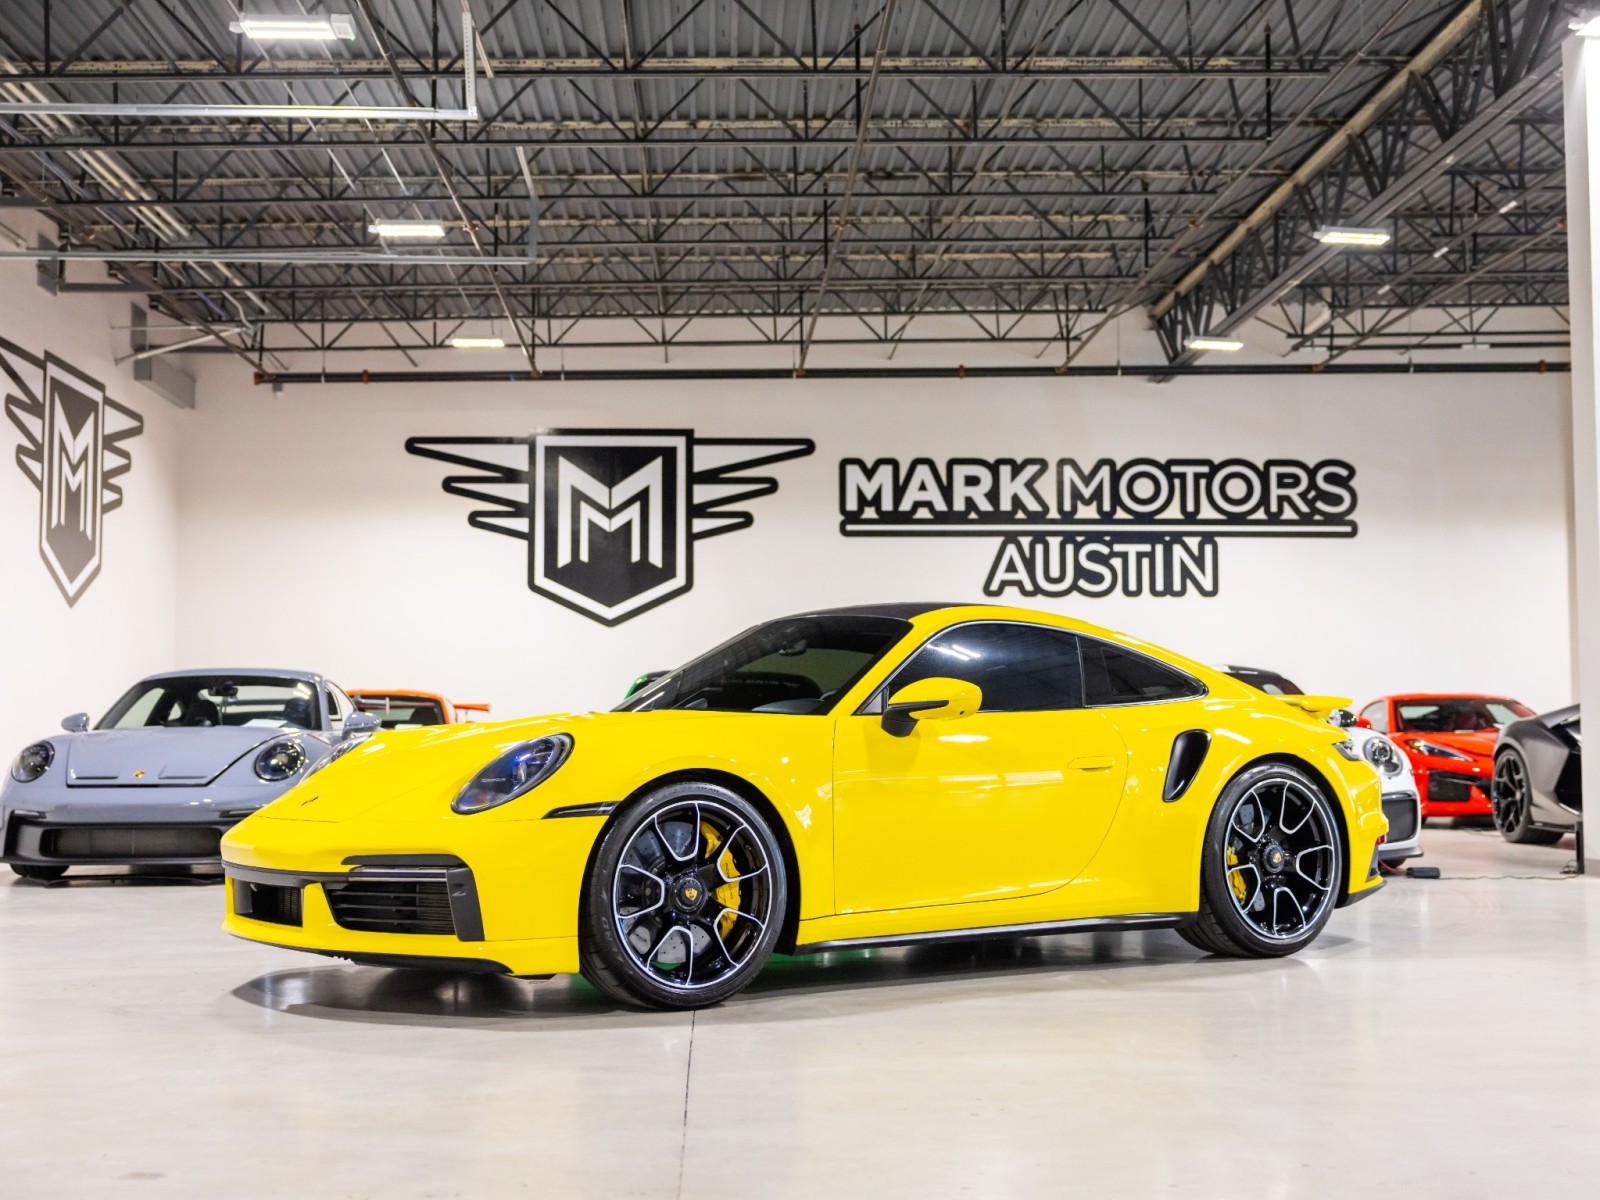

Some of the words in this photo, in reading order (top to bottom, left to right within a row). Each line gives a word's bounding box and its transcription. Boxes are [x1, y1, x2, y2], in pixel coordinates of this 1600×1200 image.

[844, 462, 1045, 512] MARK
[1060, 462, 1353, 513] MOTORS
[987, 542, 1215, 593] AUSTIN
